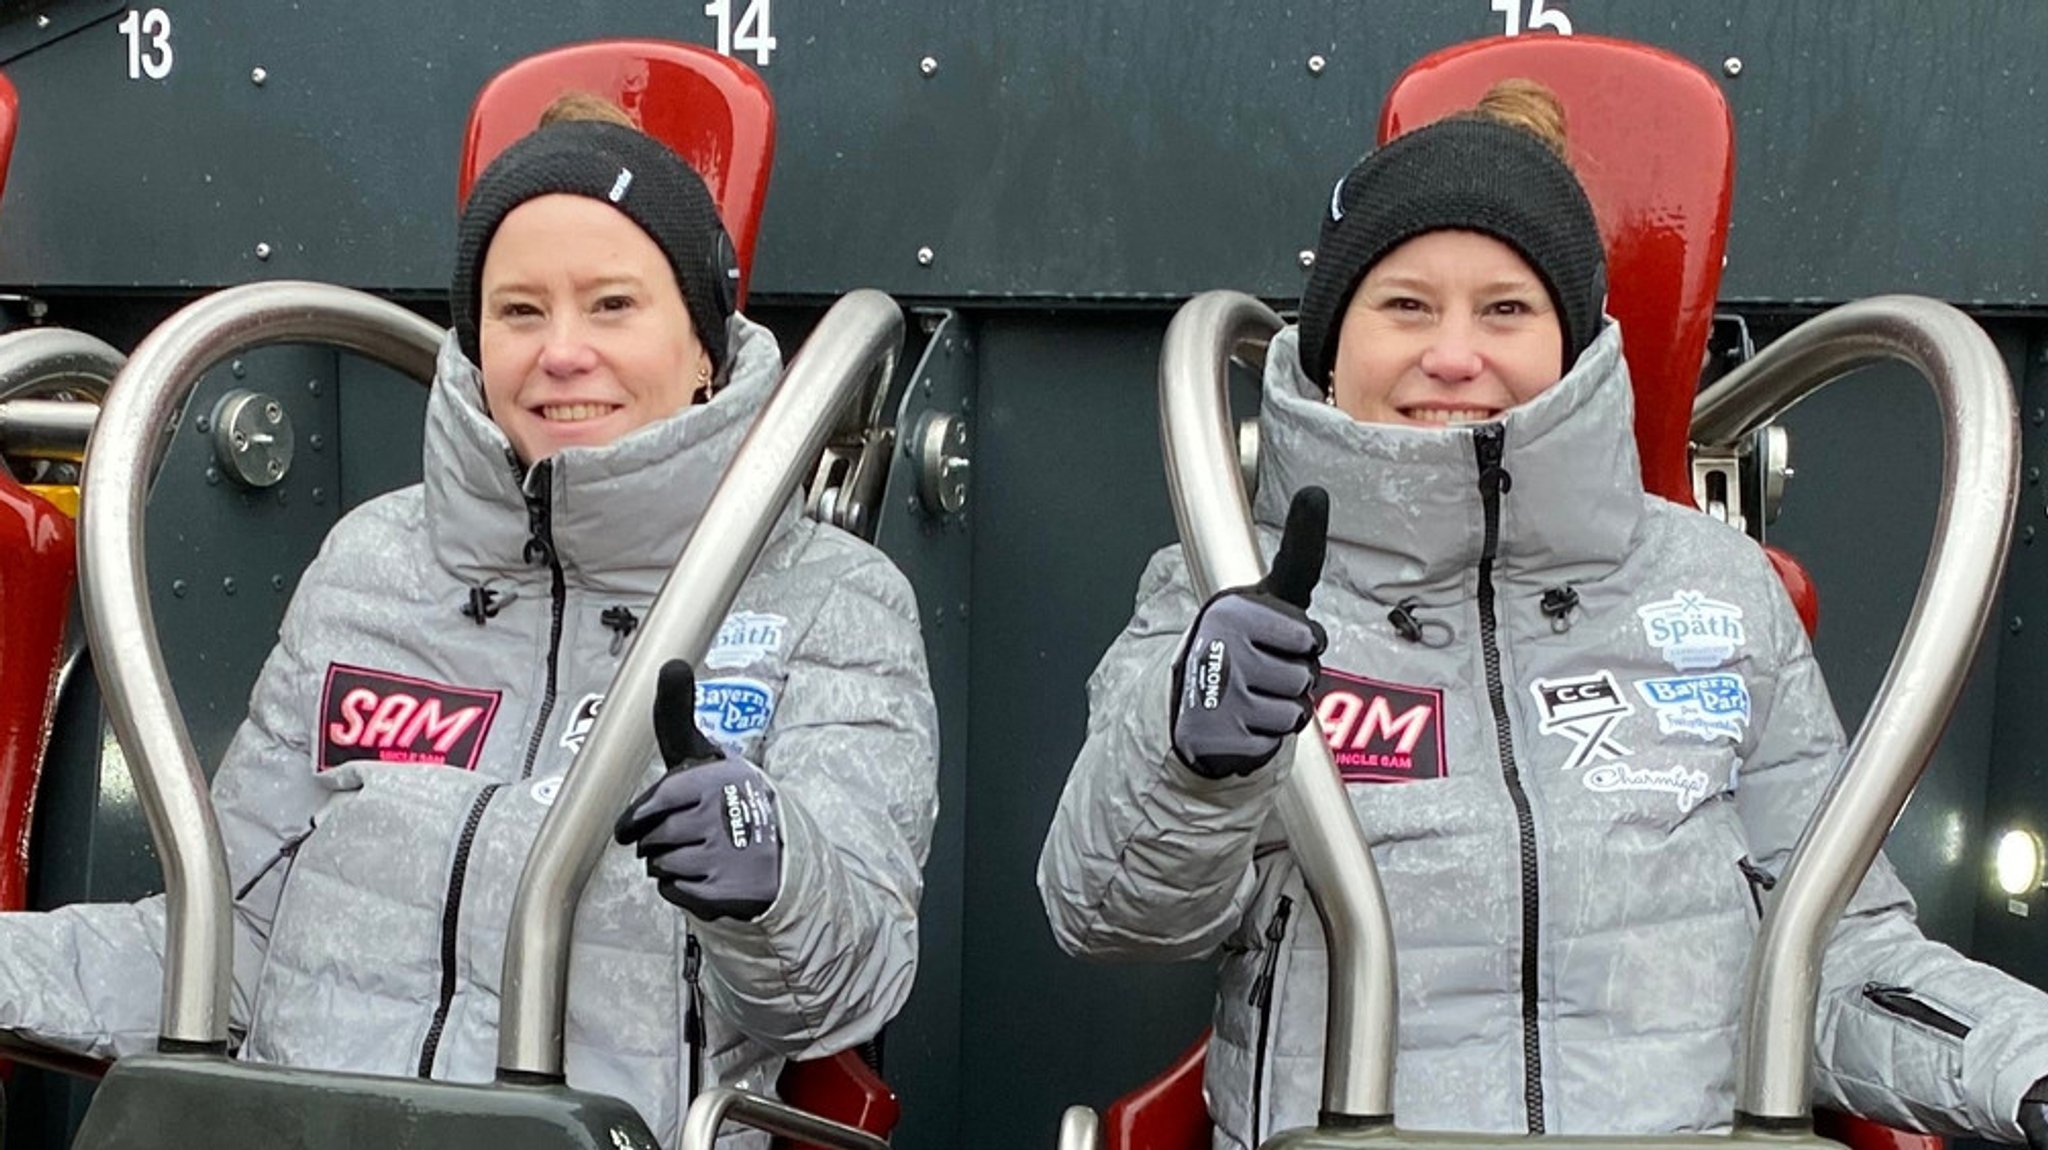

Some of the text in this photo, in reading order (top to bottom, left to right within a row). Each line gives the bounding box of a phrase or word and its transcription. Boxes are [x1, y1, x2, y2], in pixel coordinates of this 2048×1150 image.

[118, 7, 173, 79] 13
[705, 0, 777, 66] 14
[1650, 612, 1740, 644] Späth
[1203, 640, 1226, 710] STRONG
[1655, 678, 1737, 701] Bayern
[329, 688, 484, 752] SAM
[1315, 690, 1433, 754] AM
[724, 784, 748, 848] STRONG
